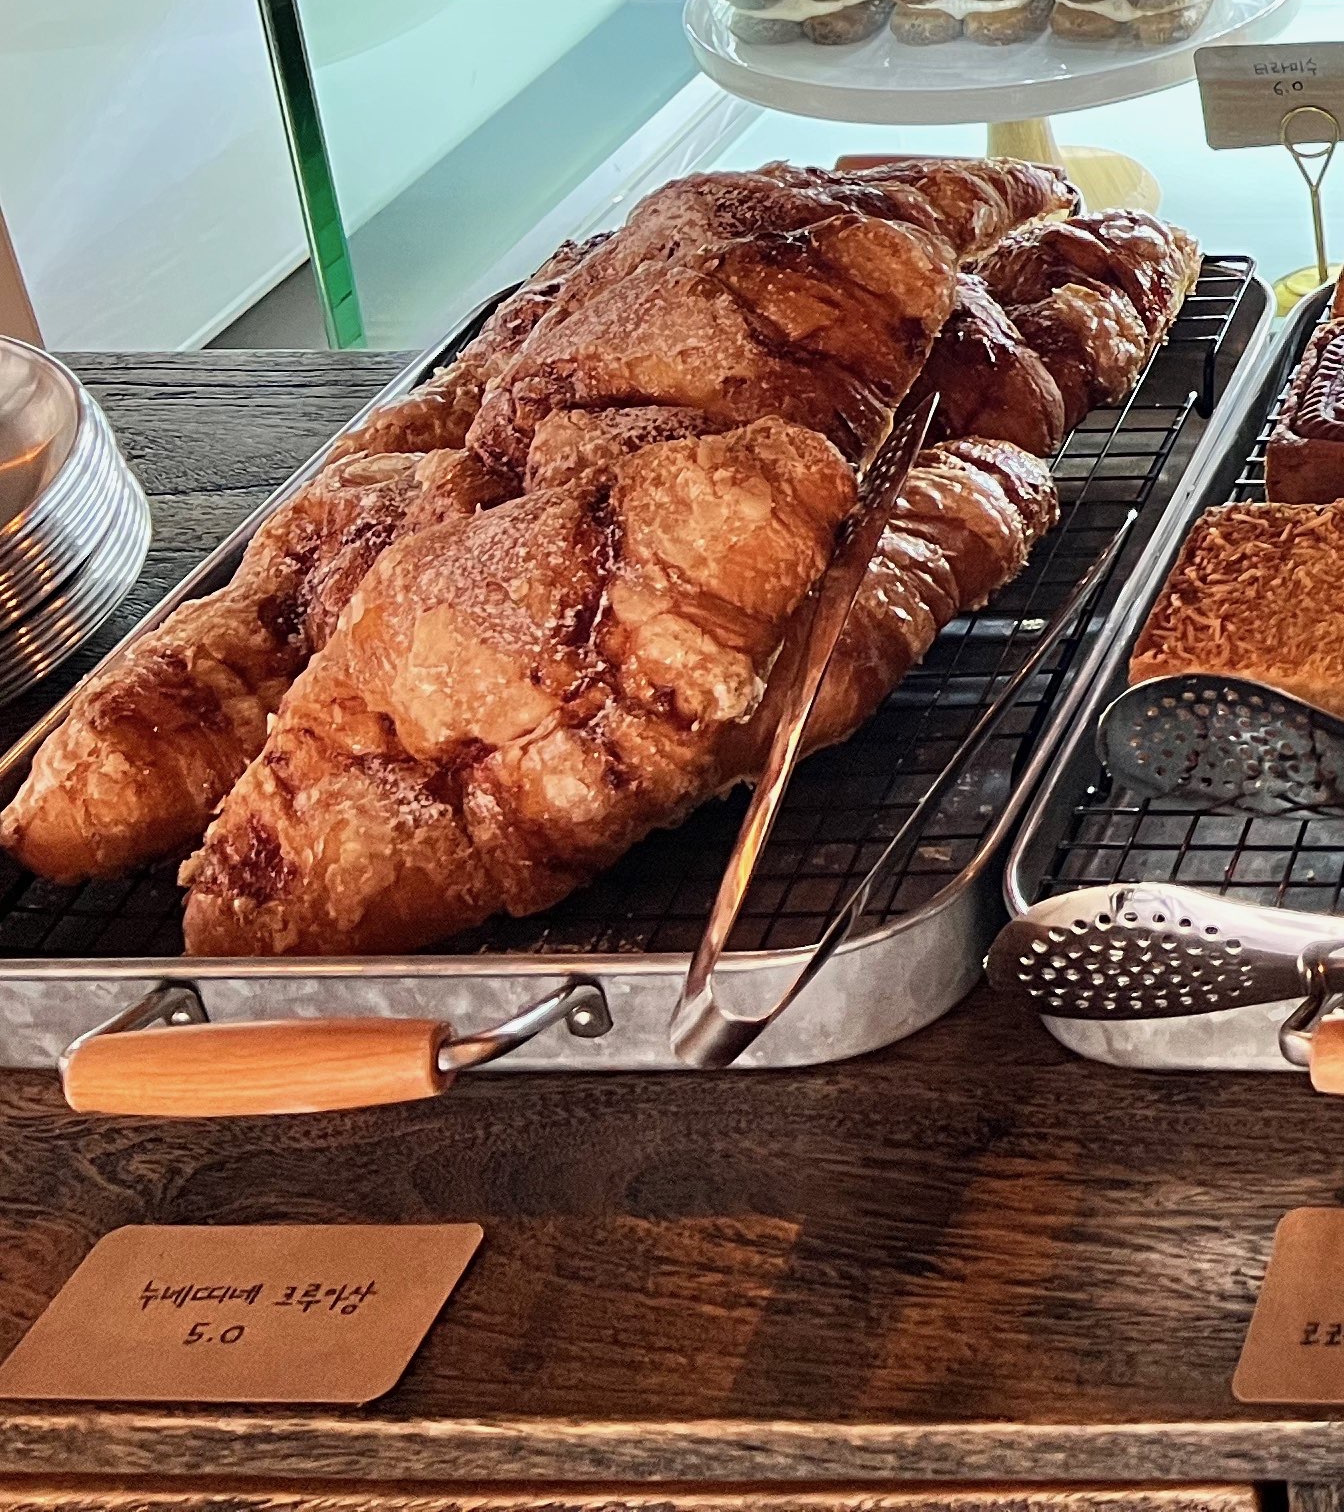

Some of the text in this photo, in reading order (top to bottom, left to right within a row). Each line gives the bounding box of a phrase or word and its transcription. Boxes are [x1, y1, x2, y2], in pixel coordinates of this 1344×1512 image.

[1254, 57, 1319, 76] 티라미수
[1273, 80, 1304, 97] 6.0
[138, 1279, 380, 1316] 누네띠네 크루아상
[181, 1321, 247, 1346] 5.0
